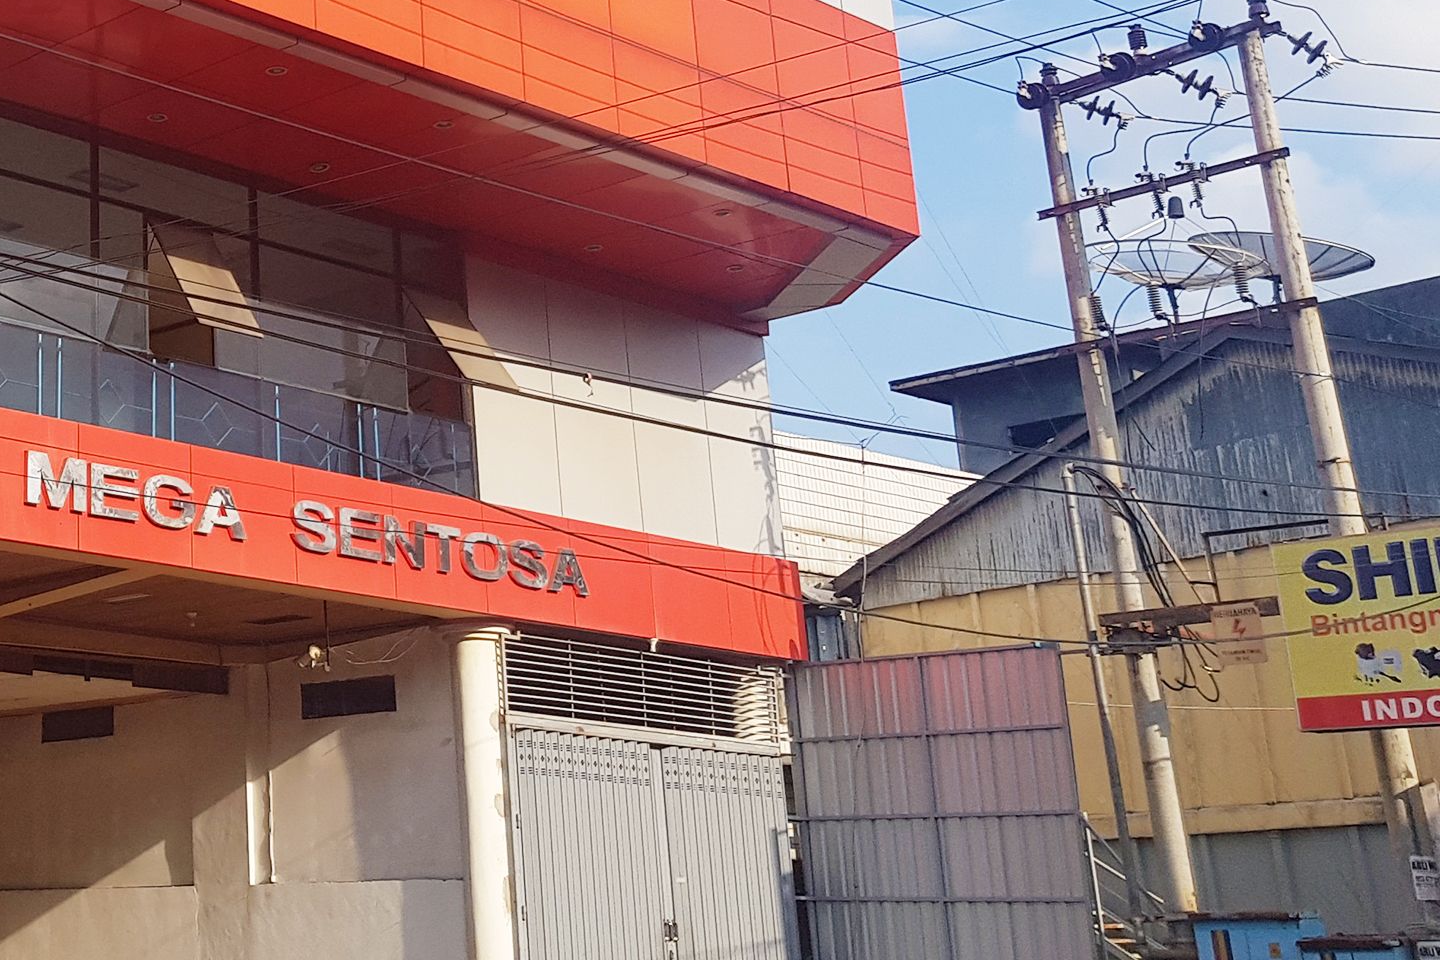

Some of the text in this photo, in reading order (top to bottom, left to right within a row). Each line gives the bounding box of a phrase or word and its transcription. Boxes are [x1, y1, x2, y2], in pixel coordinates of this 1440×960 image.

[24, 449, 248, 542] MEGA
[290, 499, 591, 597] SENTOSA
[1302, 537, 1440, 605] SHI
